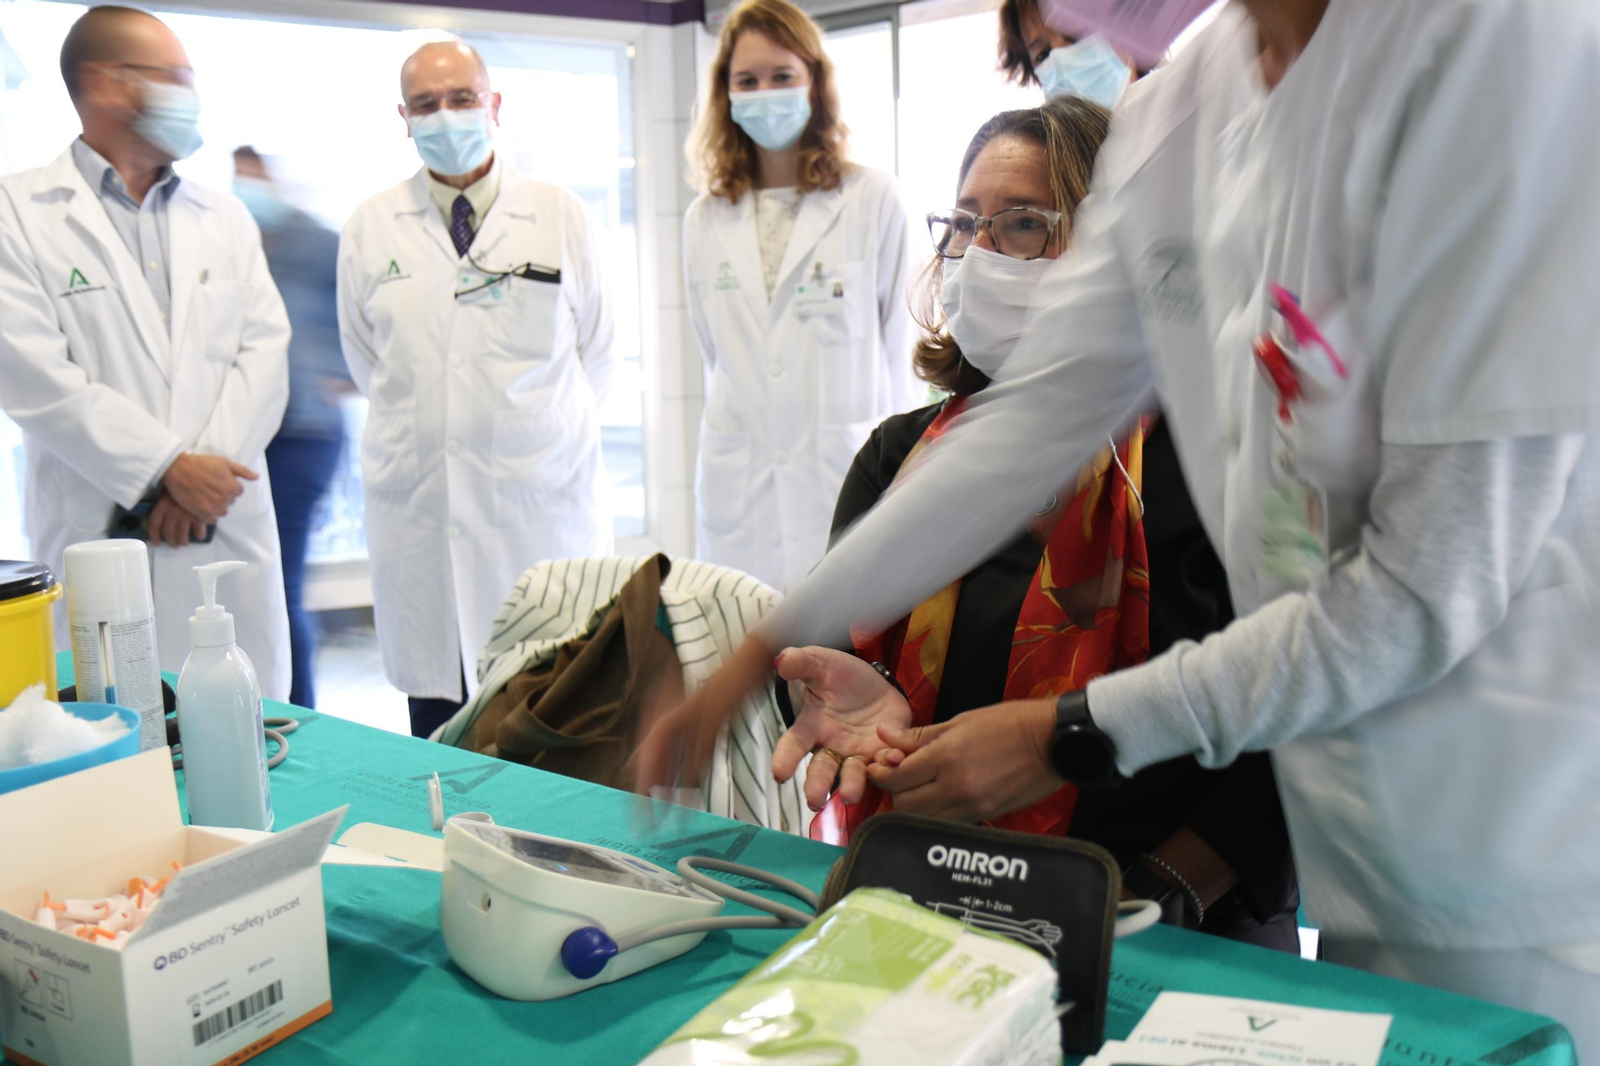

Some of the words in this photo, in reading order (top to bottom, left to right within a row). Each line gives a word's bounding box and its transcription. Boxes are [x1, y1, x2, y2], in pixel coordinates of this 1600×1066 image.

[588, 836, 642, 854] Junta
[643, 851, 669, 861] de
[927, 844, 1029, 881] OMRON
[168, 947, 189, 965] BD
[231, 914, 265, 936] Safety
[267, 896, 301, 920] Lancet
